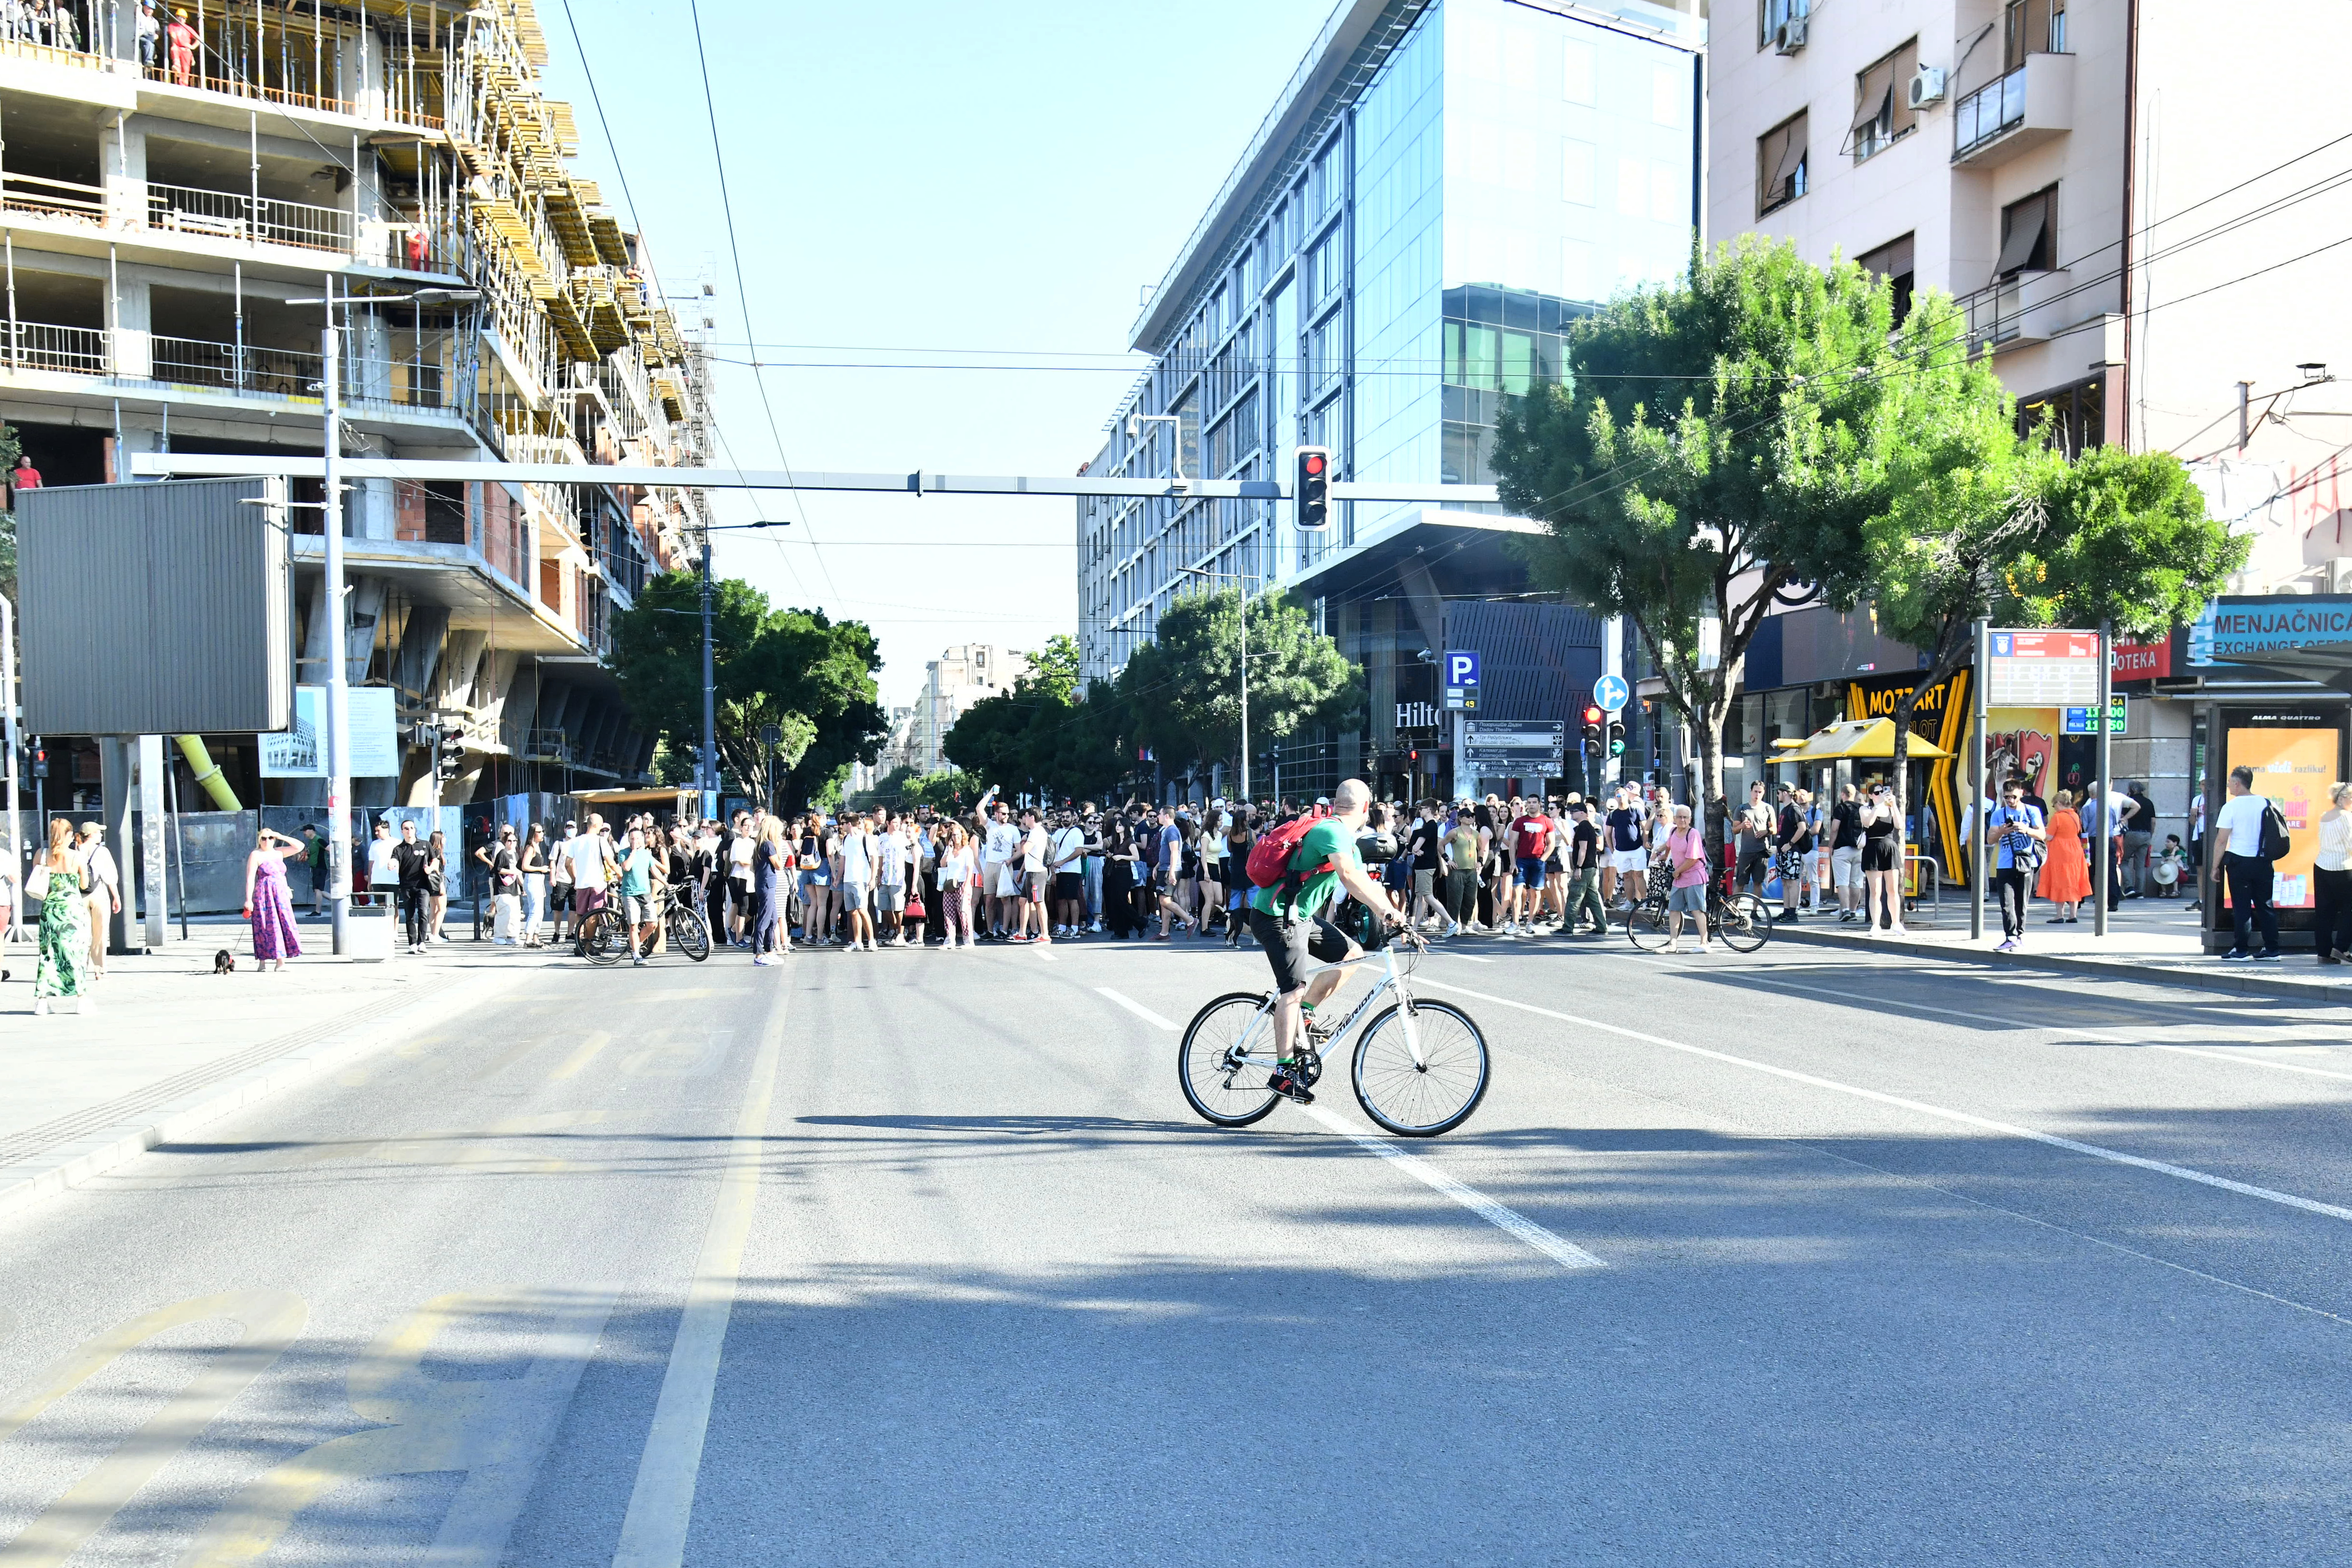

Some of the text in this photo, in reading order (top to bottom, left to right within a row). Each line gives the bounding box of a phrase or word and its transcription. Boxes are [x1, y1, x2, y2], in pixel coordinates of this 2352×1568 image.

[1453, 657, 1473, 683] P
[2113, 651, 2157, 671] OTEKA
[2295, 764, 2326, 773] razliku!
[1336, 988, 1375, 1037] MERIDA
